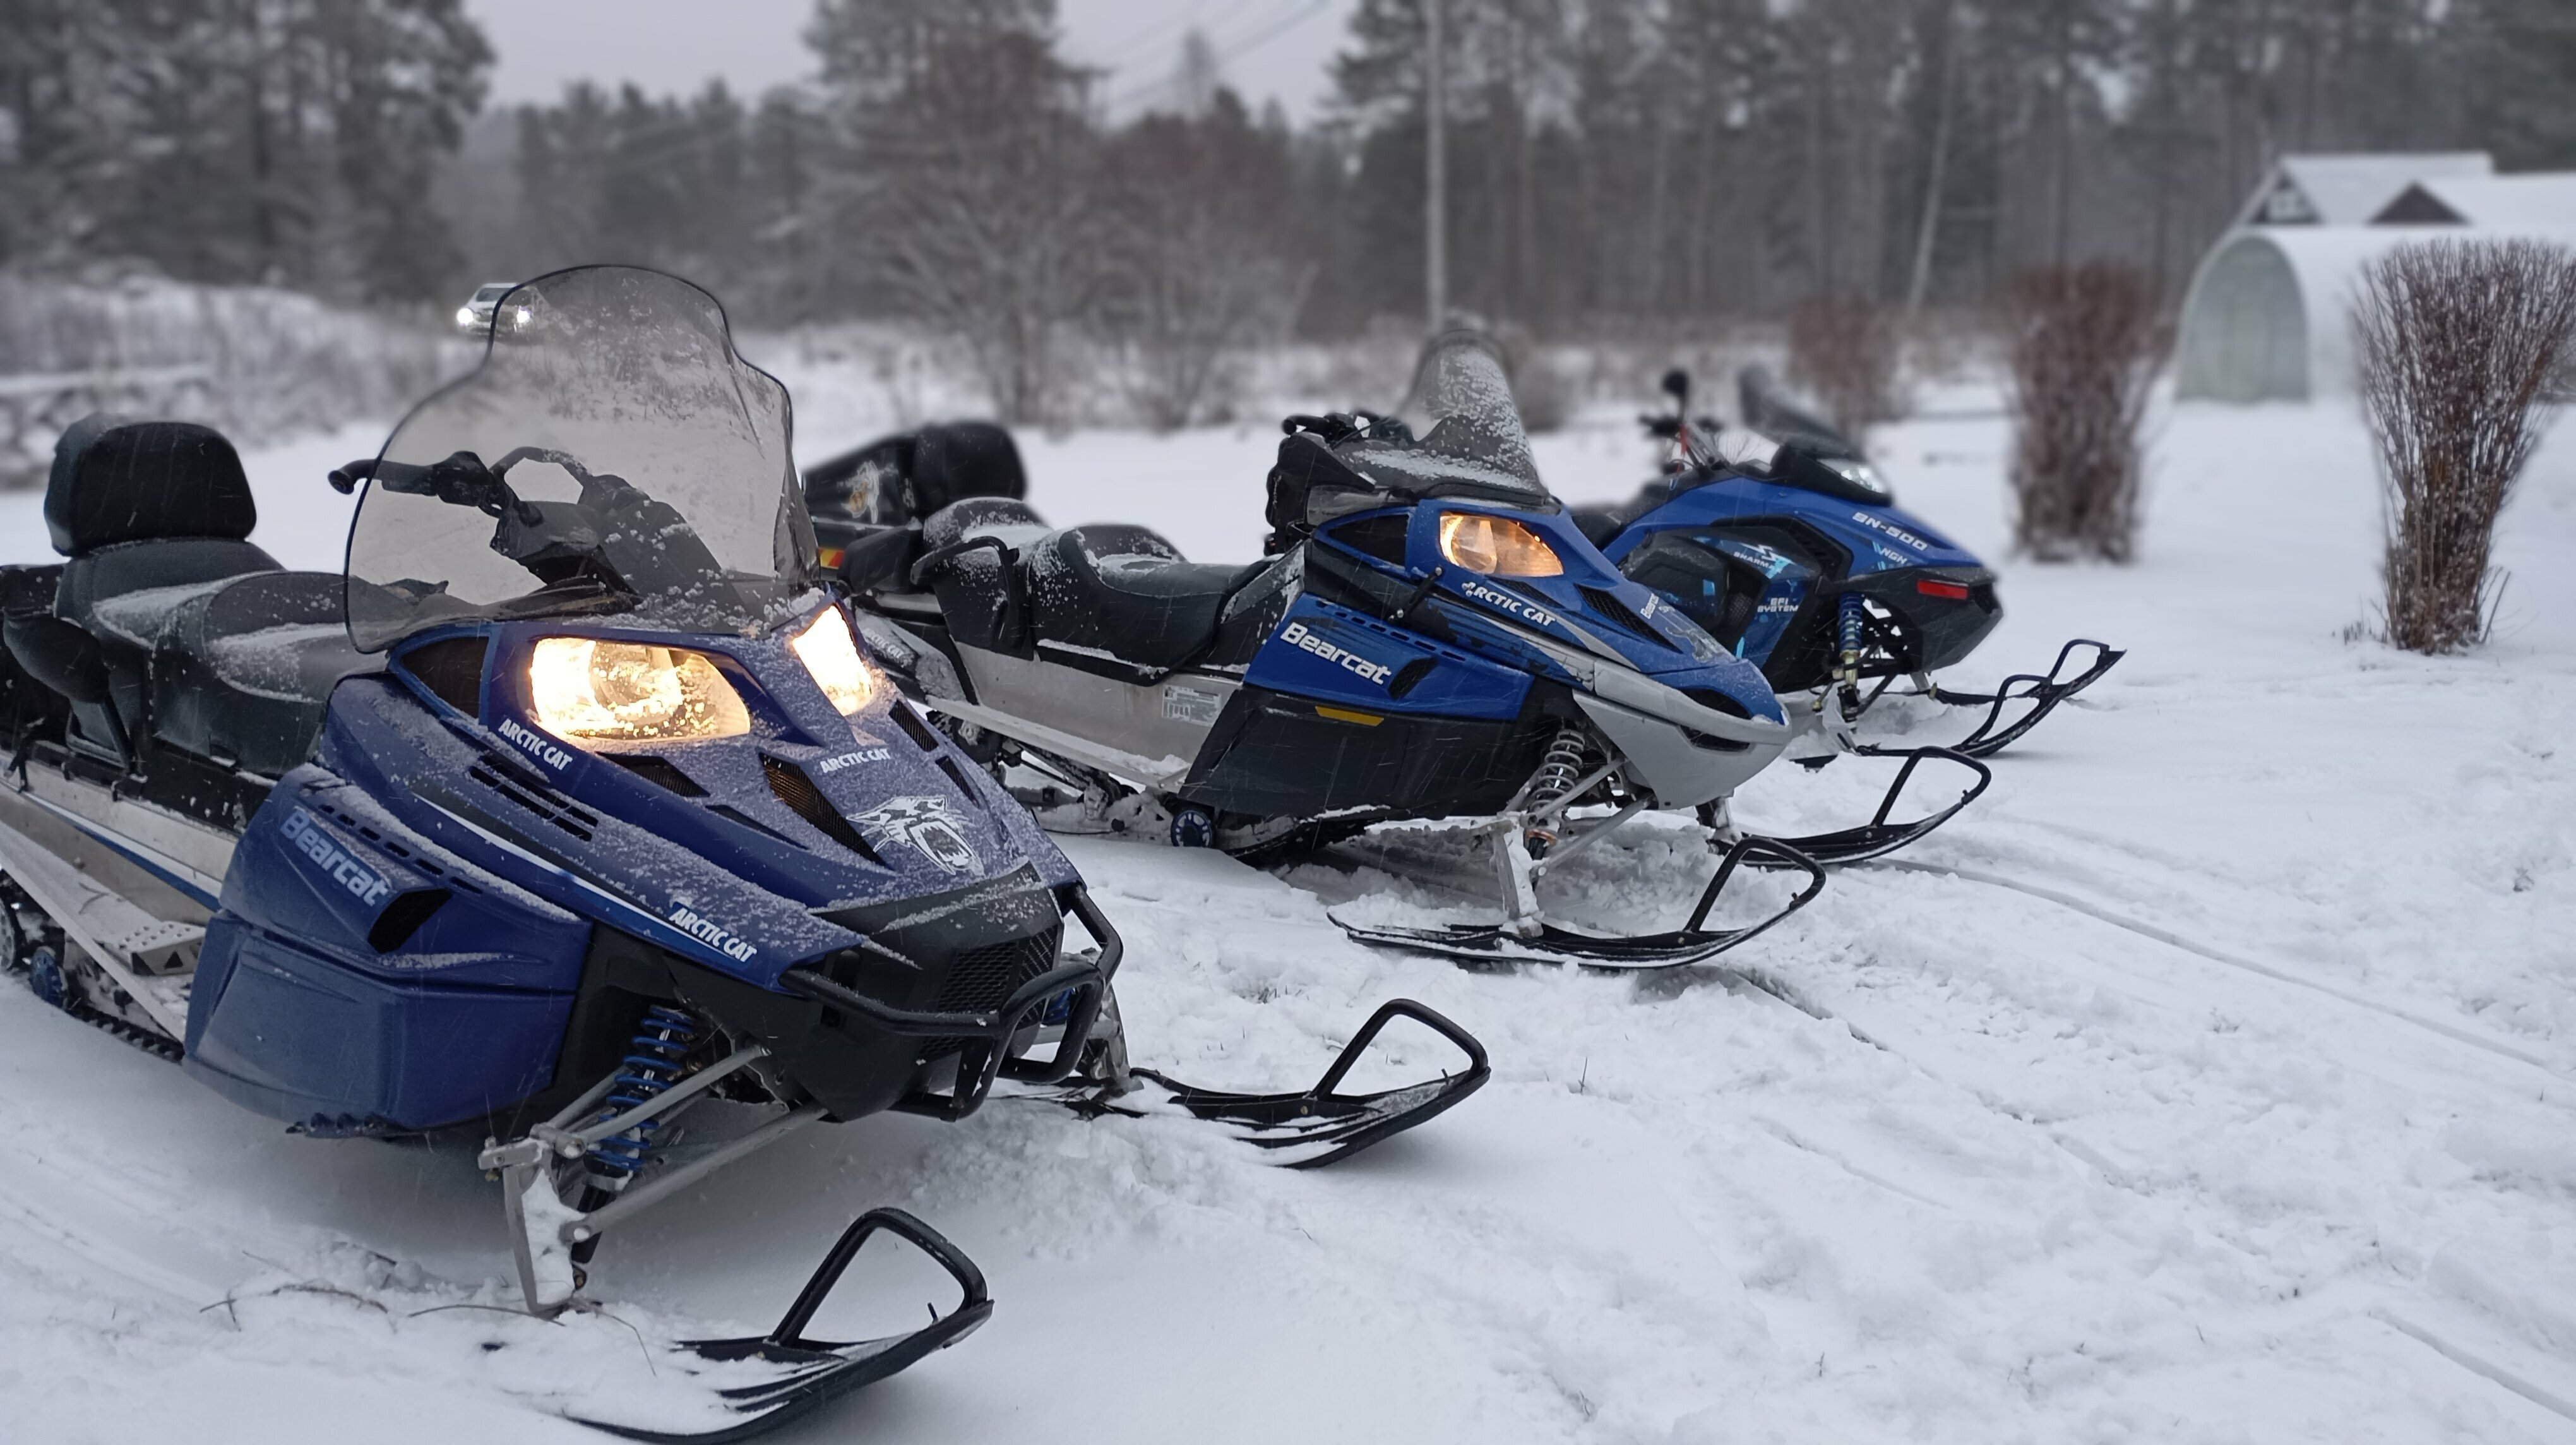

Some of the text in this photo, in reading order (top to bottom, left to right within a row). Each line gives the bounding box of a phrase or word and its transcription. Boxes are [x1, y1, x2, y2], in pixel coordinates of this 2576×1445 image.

[1523, 608, 1556, 626] CAT
[1280, 621, 1392, 685] Bearcat
[498, 718, 573, 770] ARCTIC CAT
[820, 748, 891, 773] ARCTIC CAT
[280, 809, 388, 907] Bearcat
[669, 908, 758, 962] ARCTIC CAT
